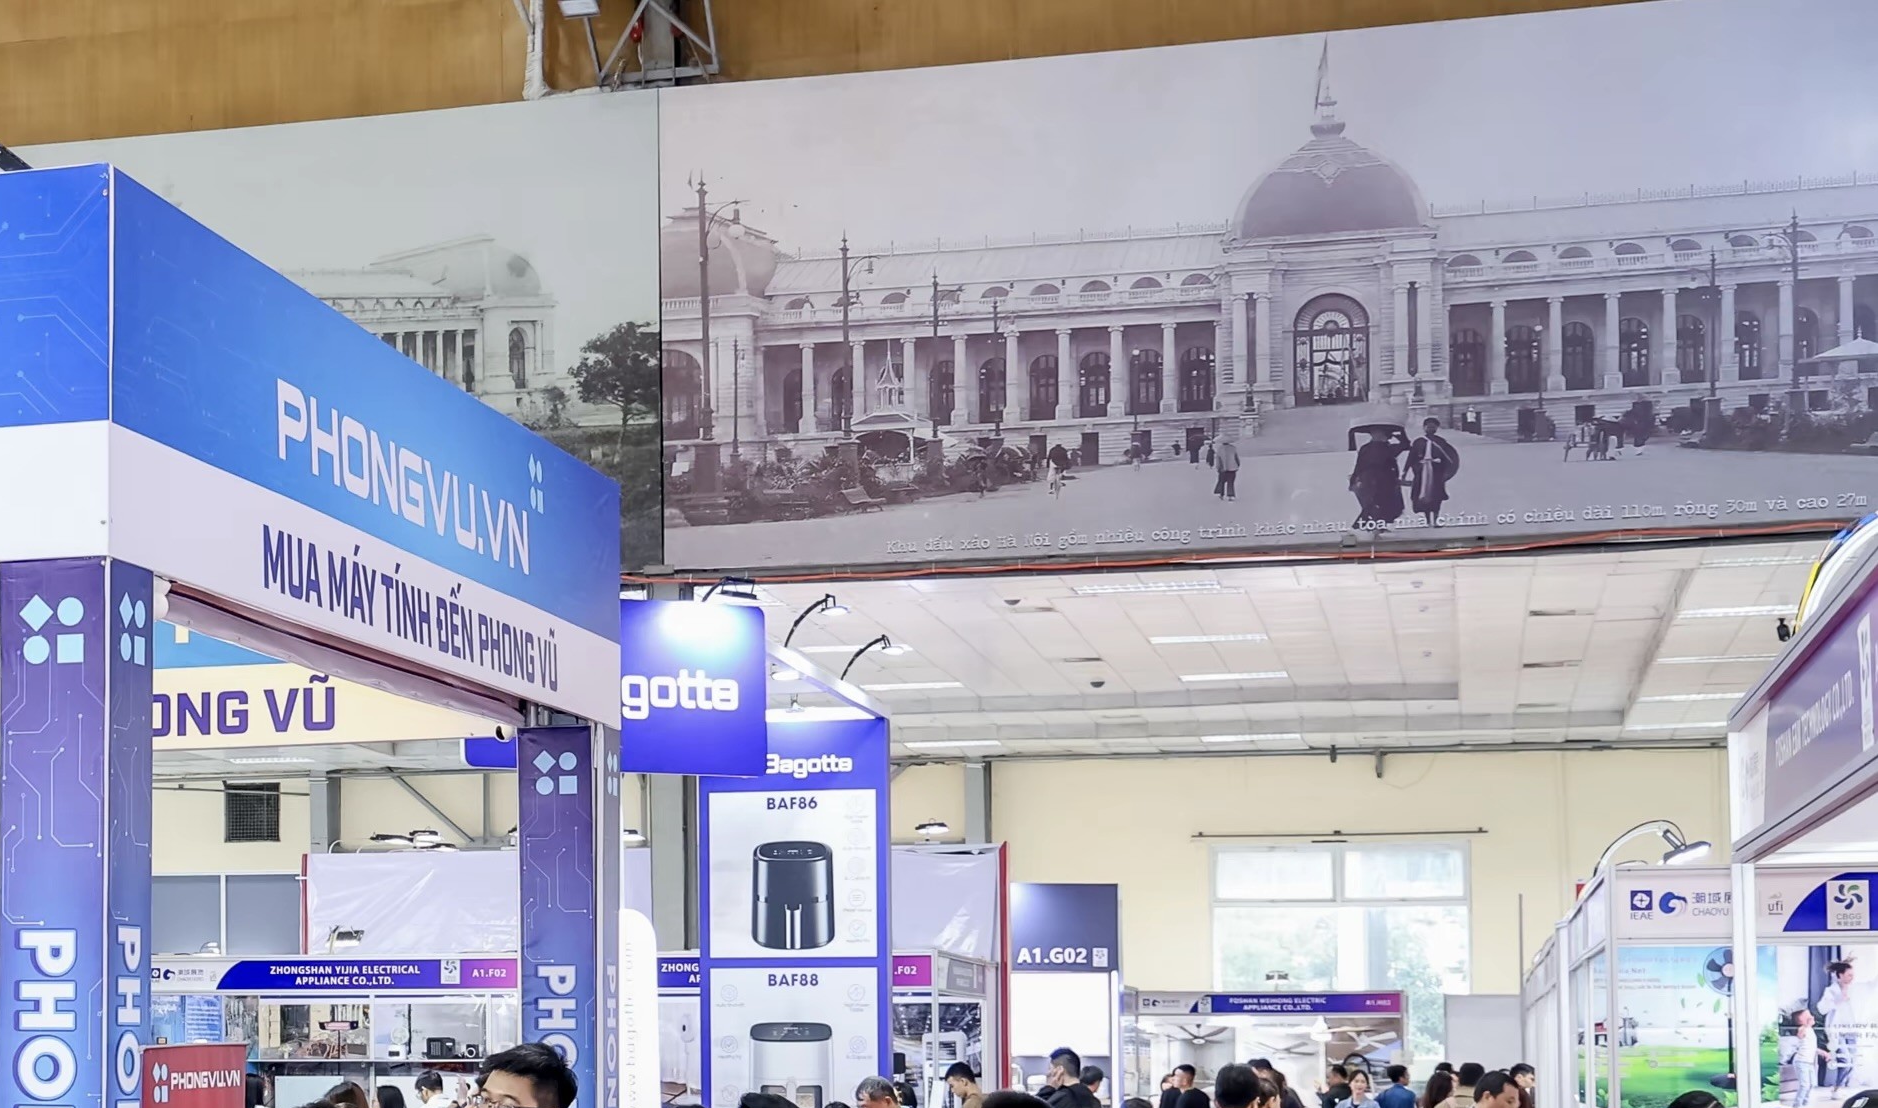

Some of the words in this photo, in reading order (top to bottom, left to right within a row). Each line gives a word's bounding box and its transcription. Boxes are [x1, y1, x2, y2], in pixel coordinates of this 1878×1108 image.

[276, 377, 530, 576] PHONGVU.VN
[1151, 526, 1192, 544] công
[1198, 522, 1248, 540] trình
[1254, 520, 1296, 538] khác
[1358, 514, 1387, 532] tòa
[1497, 509, 1516, 525] có
[1523, 503, 1575, 524] chiều
[1583, 504, 1614, 521] dài
[1674, 500, 1719, 519] rộng
[1726, 498, 1758, 514] 30m
[1765, 496, 1789, 512] và
[1796, 496, 1829, 510] cao
[1836, 493, 1868, 509] 27m
[263, 523, 323, 608] MUA
[327, 543, 377, 628] MÁY
[380, 562, 433, 649] TÍNH
[435, 582, 475, 663] ĐẾN
[478, 613, 536, 684] PHONG
[538, 627, 558, 693] VŨ
[263, 673, 336, 732] VŨ
[766, 796, 818, 811] BAF86
[1630, 911, 1654, 920] IEAE
[1016, 947, 1088, 964] A1.G02
[269, 965, 332, 975] ZHONGSHAN
[334, 965, 361, 975] YIJIA
[362, 965, 421, 975] ELECTRICAL
[471, 968, 507, 979] A1.F02
[660, 962, 700, 973] ZHONG
[295, 976, 350, 986] APPLIANCE
[351, 976, 395, 987] CO.,LTD.
[767, 972, 819, 987] BAF88
[170, 1069, 241, 1090] PHONGVU.VN
